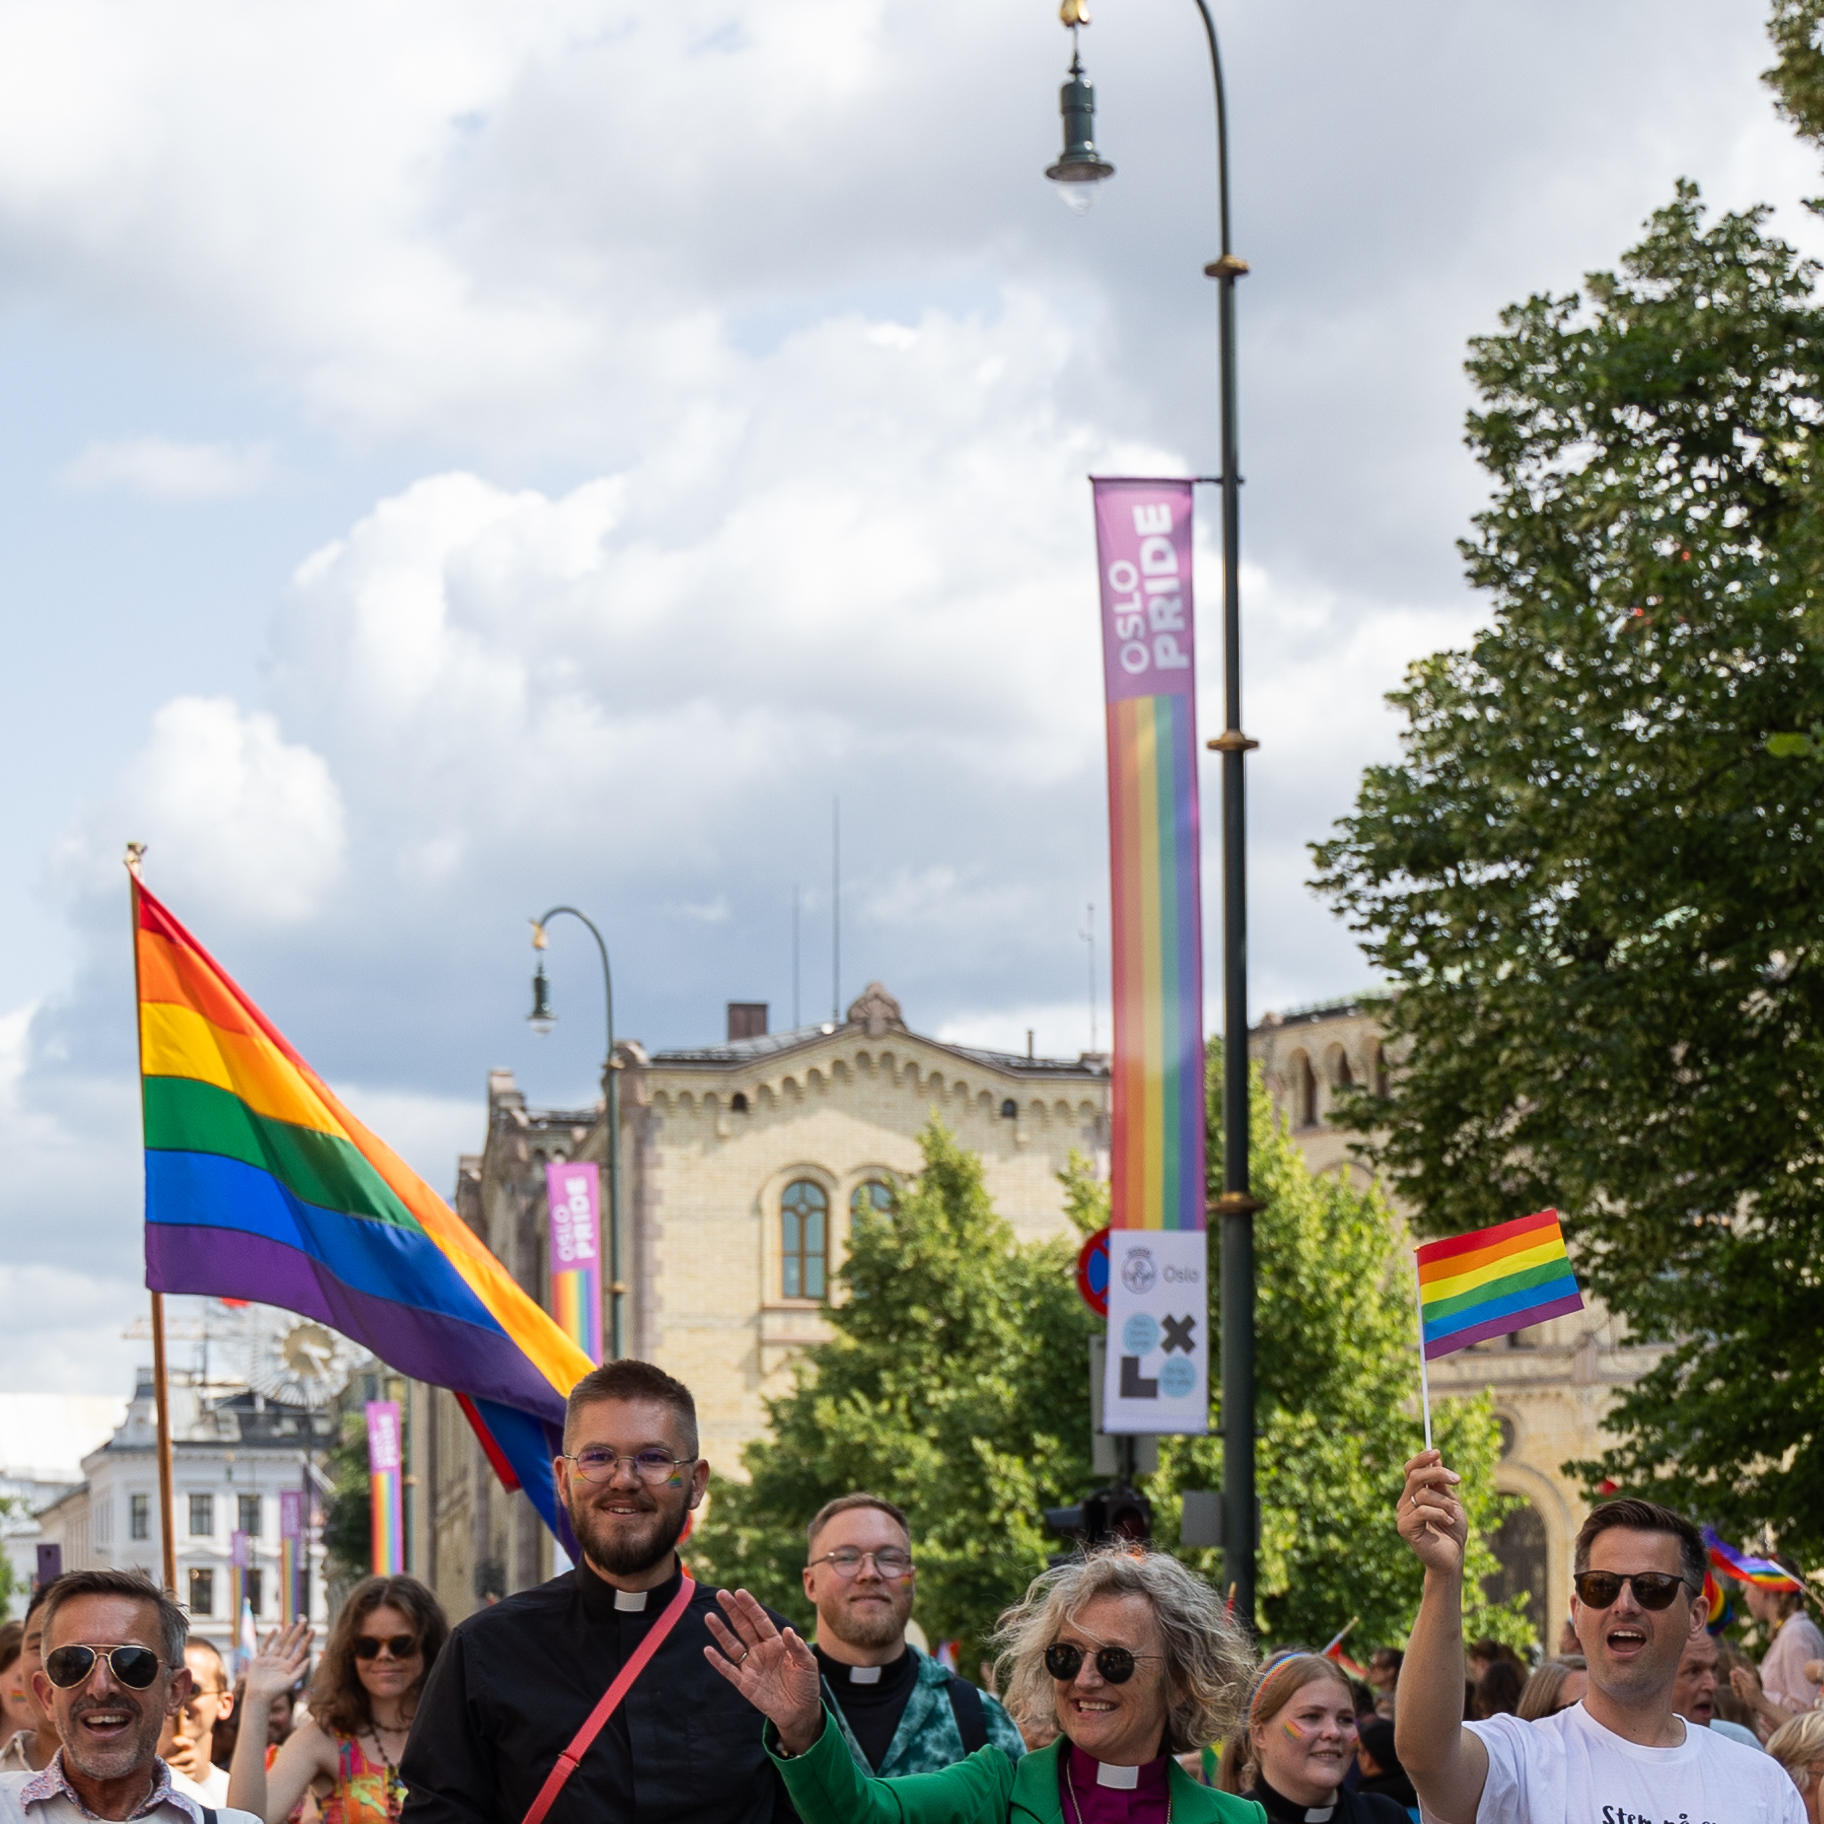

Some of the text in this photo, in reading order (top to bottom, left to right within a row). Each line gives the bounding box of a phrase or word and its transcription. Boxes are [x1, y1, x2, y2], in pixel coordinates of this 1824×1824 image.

[1107, 558, 1150, 675] OSLO
[1131, 502, 1191, 670] PRIDE
[565, 1176, 596, 1259] PRIDE
[1163, 1265, 1199, 1284] Oslo
